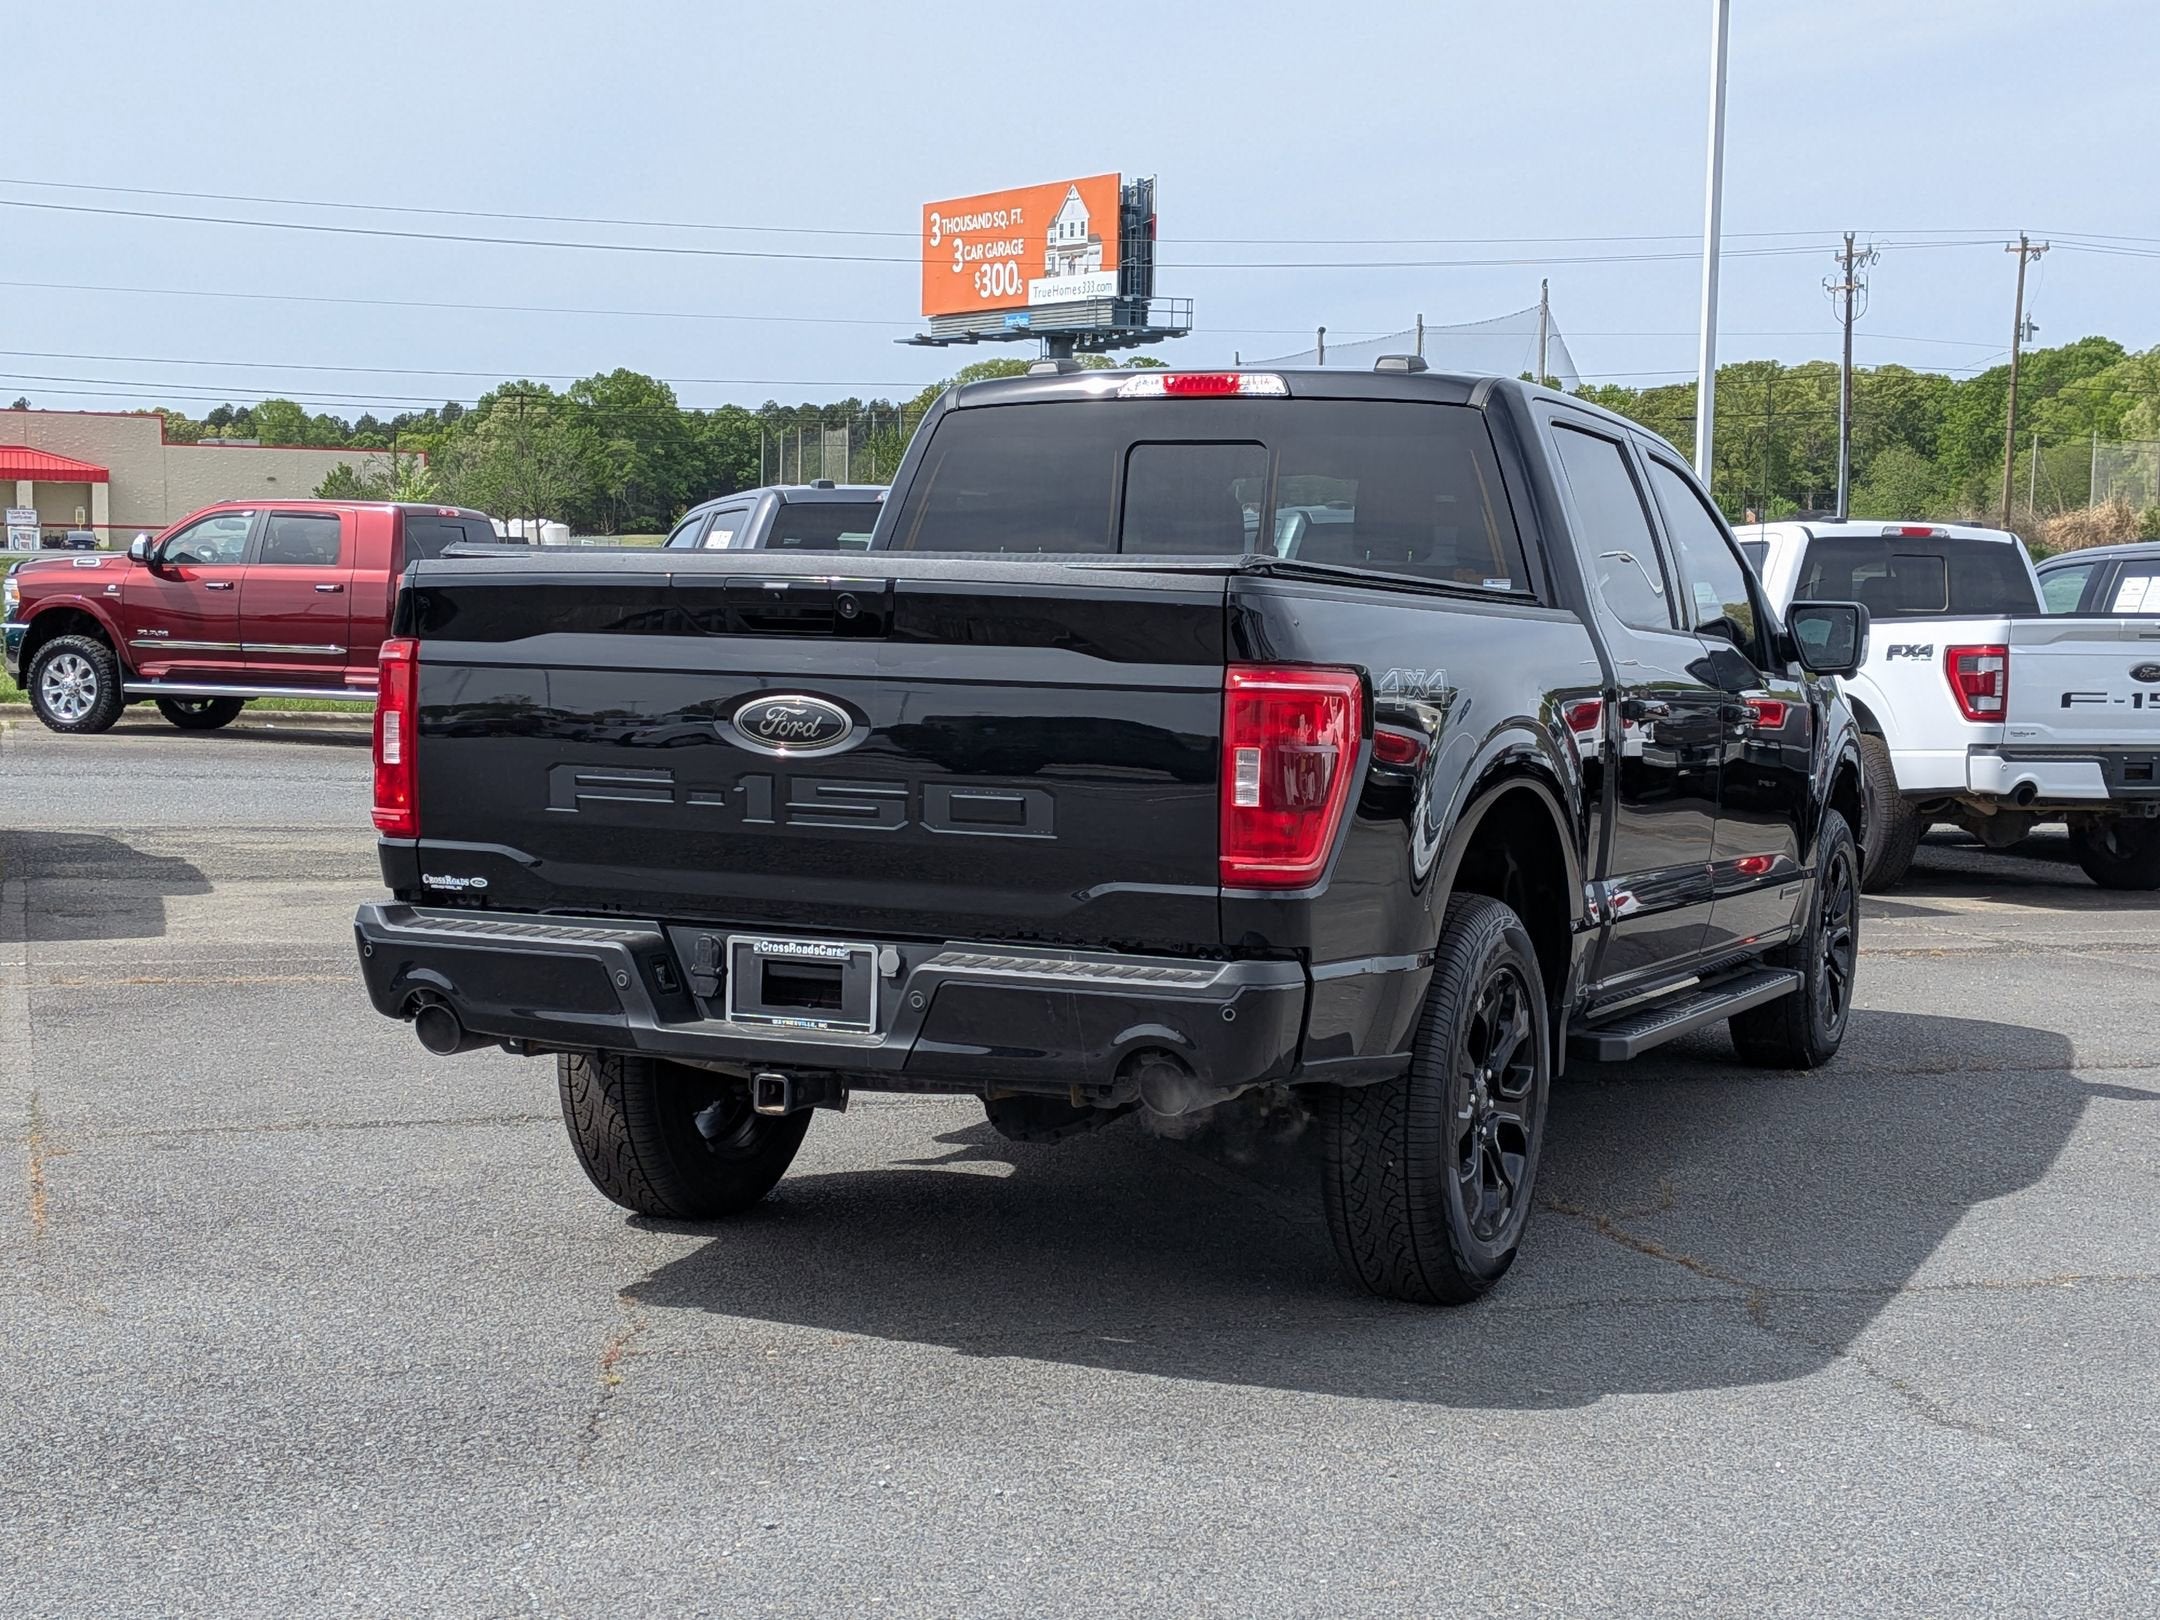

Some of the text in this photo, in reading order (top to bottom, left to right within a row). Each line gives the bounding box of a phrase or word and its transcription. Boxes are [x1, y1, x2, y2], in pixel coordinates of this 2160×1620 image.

[929, 208, 1024, 247] 3 THOUSAND SQ. FT.
[952, 238, 1024, 273] 3 CAR GARAGE
[1033, 281, 1113, 298] TrueHomes333.com
[1886, 644, 1933, 661] FX4
[2061, 692, 2160, 709] F-1
[760, 706, 822, 737] Ford
[544, 762, 1058, 839] F-150
